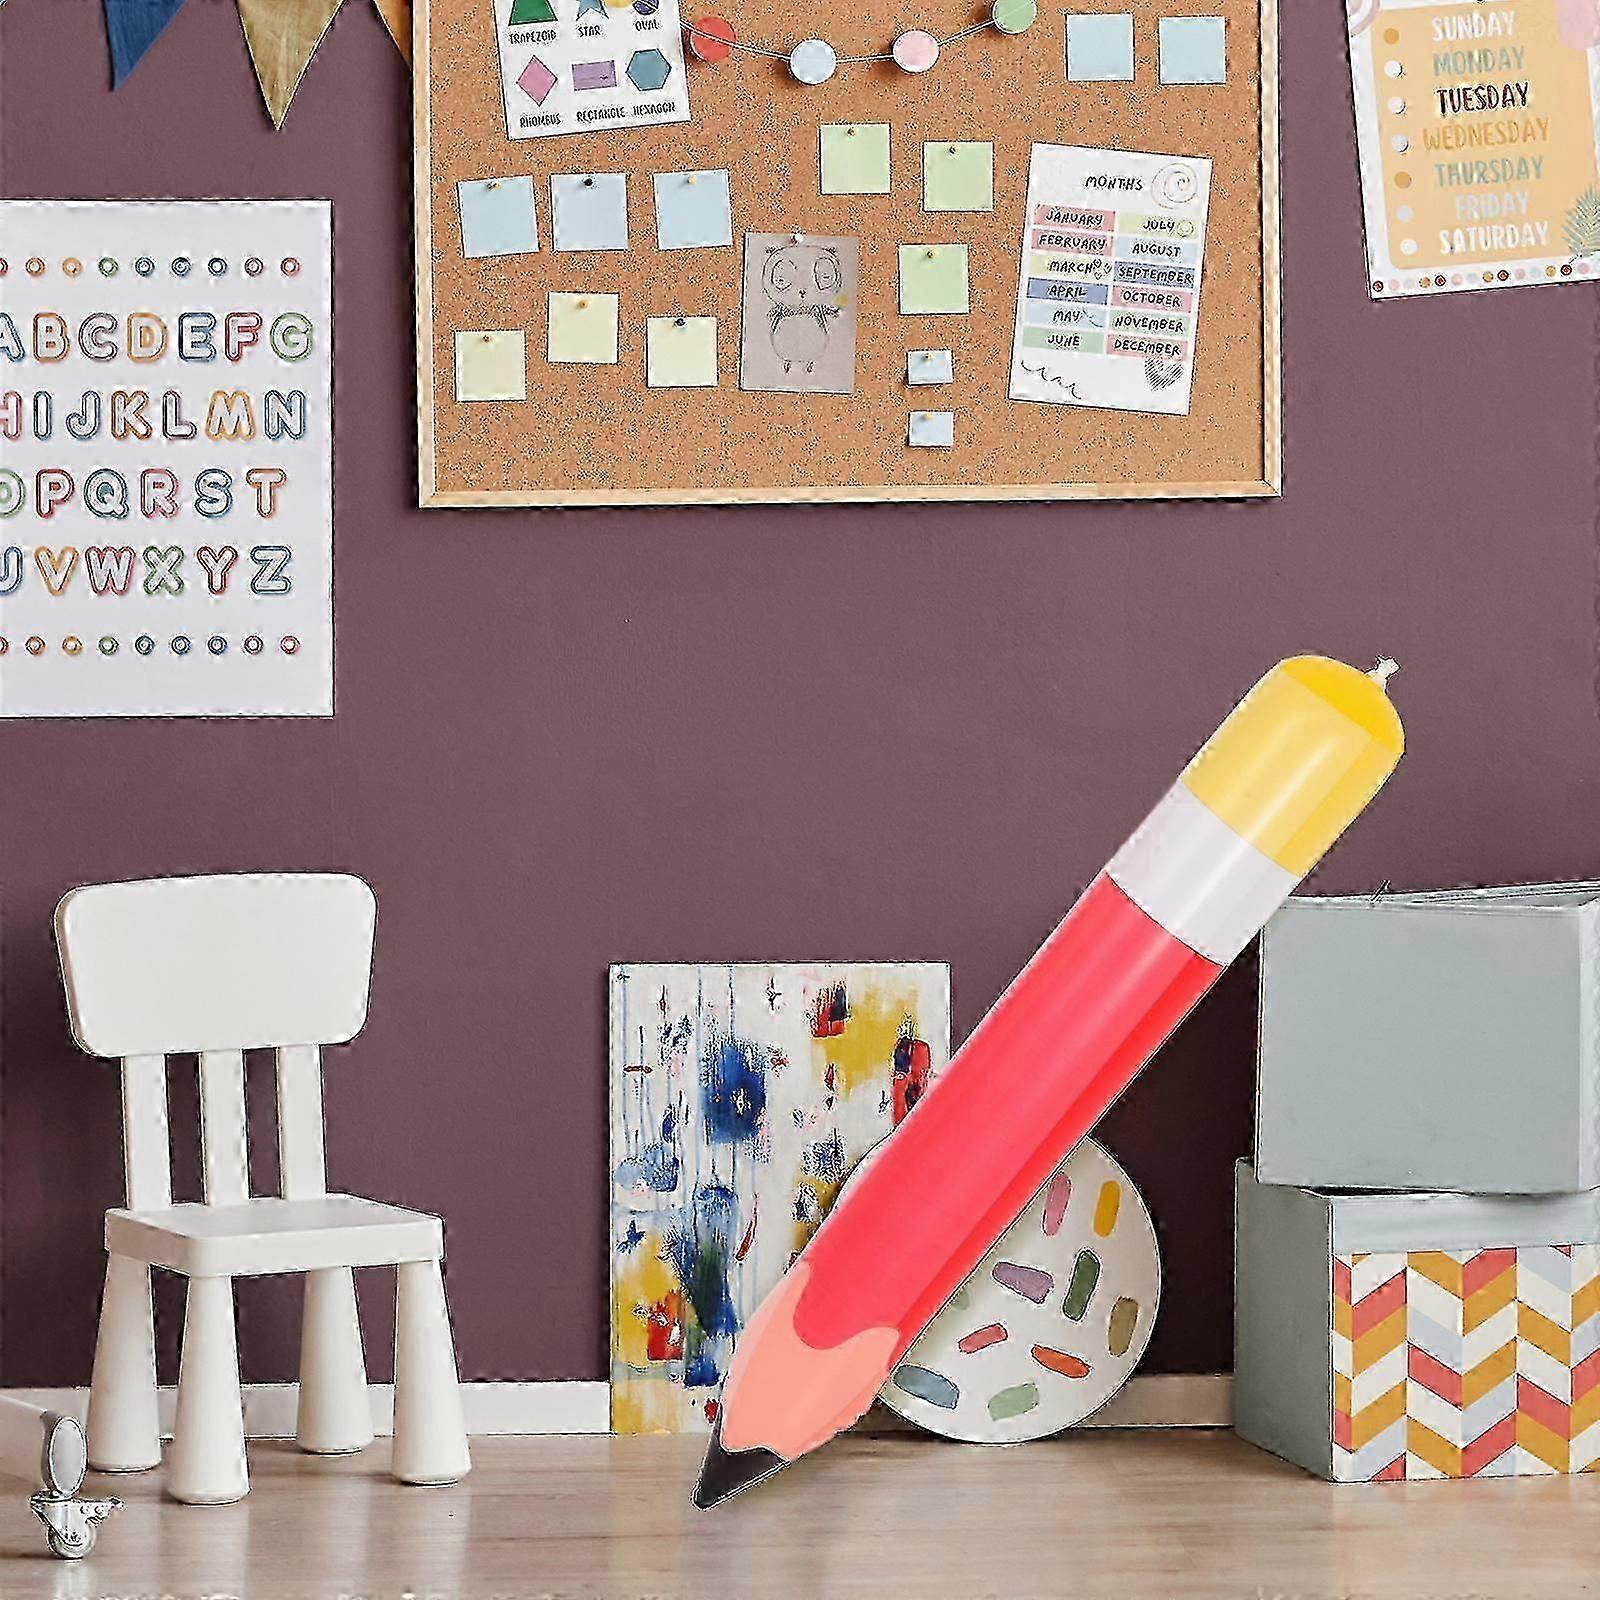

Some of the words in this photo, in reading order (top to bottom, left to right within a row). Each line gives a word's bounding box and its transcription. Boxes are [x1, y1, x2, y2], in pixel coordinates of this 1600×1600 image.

[577, 26, 601, 38] STAR
[1431, 10, 1516, 42] SUNDAY
[1432, 46, 1526, 76] MONDAY
[1436, 81, 1530, 117] TUESDAY
[519, 113, 562, 129] RHOMBUS
[576, 107, 626, 122] RECTANGLE
[633, 103, 676, 117] HEXAGON
[1422, 117, 1551, 151] WEDNESDAY
[1435, 155, 1544, 187] THURSDAY
[1085, 175, 1144, 192] MONTHS
[1456, 191, 1530, 221] FRIDAY
[1045, 211, 1104, 226] JANUARY
[1142, 219, 1176, 232] JULY
[1038, 234, 1106, 250] FEBRUARY
[1439, 221, 1550, 255] SATURDAY
[1132, 246, 1181, 258] AUGUST
[1049, 260, 1093, 274] MARCH
[1118, 266, 1195, 283] SEPTEMBER
[1049, 285, 1087, 297] APRIL
[1122, 290, 1182, 307] OCTOBER
[1052, 309, 1081, 321] MAY
[1114, 315, 1184, 332] NOVEMBER
[1047, 334, 1080, 347] JUNE
[1114, 338, 1182, 356] DECEMBER
